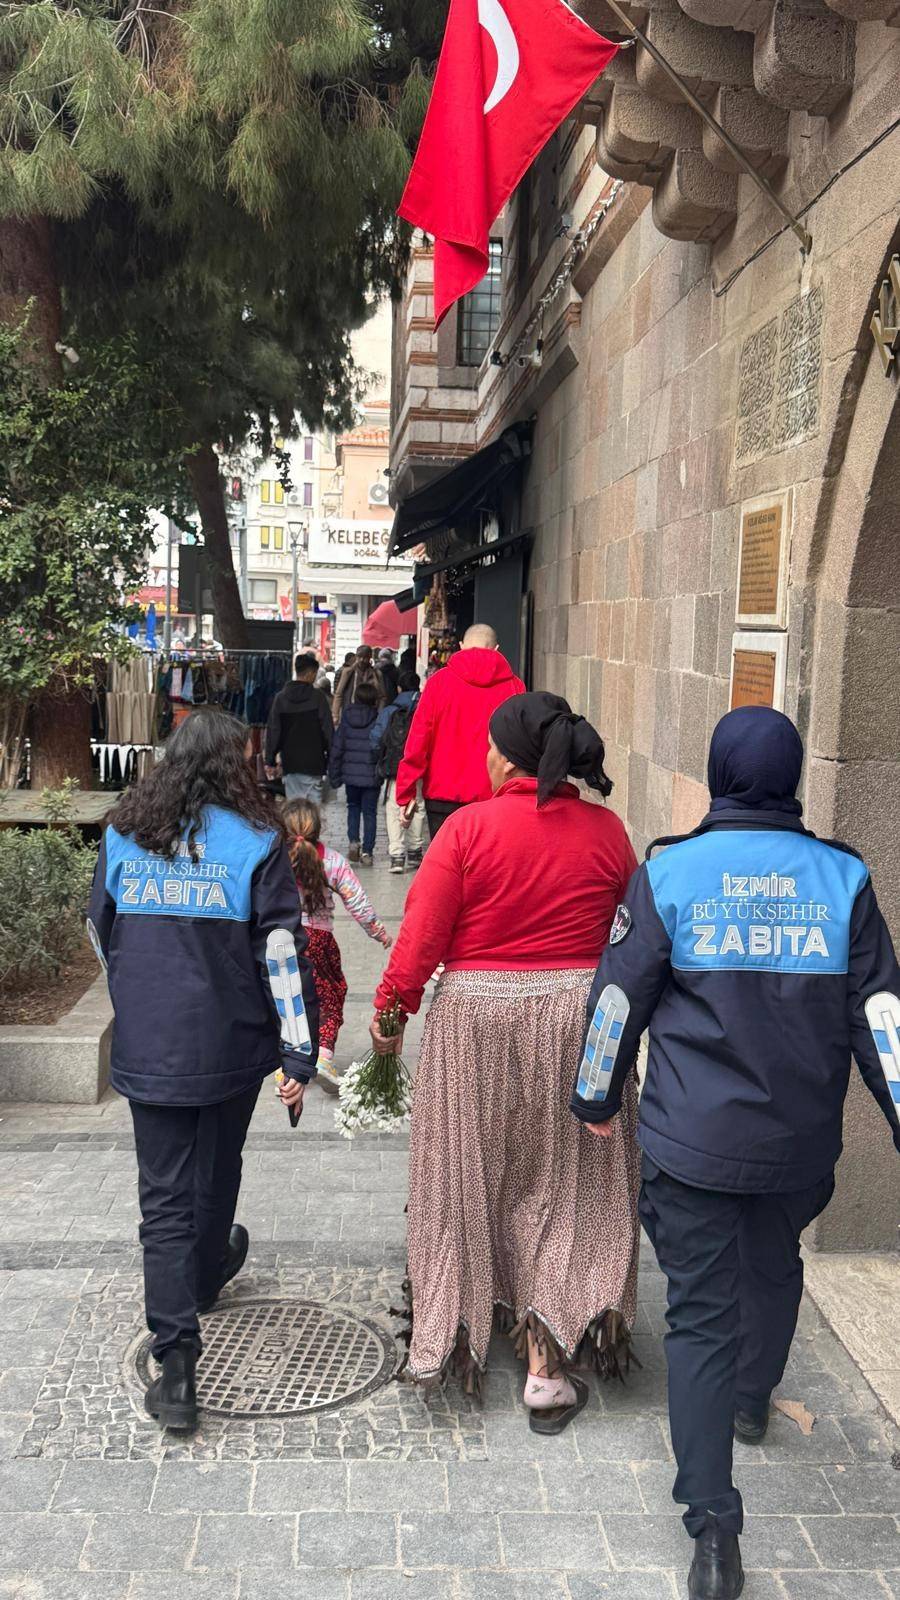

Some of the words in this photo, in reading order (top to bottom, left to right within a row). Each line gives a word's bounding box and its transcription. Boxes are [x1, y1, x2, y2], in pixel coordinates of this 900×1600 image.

[122, 878, 227, 908] ZABITA
[722, 872, 798, 897] İZMİR
[691, 898, 831, 924] BÜYÜKŞEHİR
[692, 924, 830, 958] ZABITA
